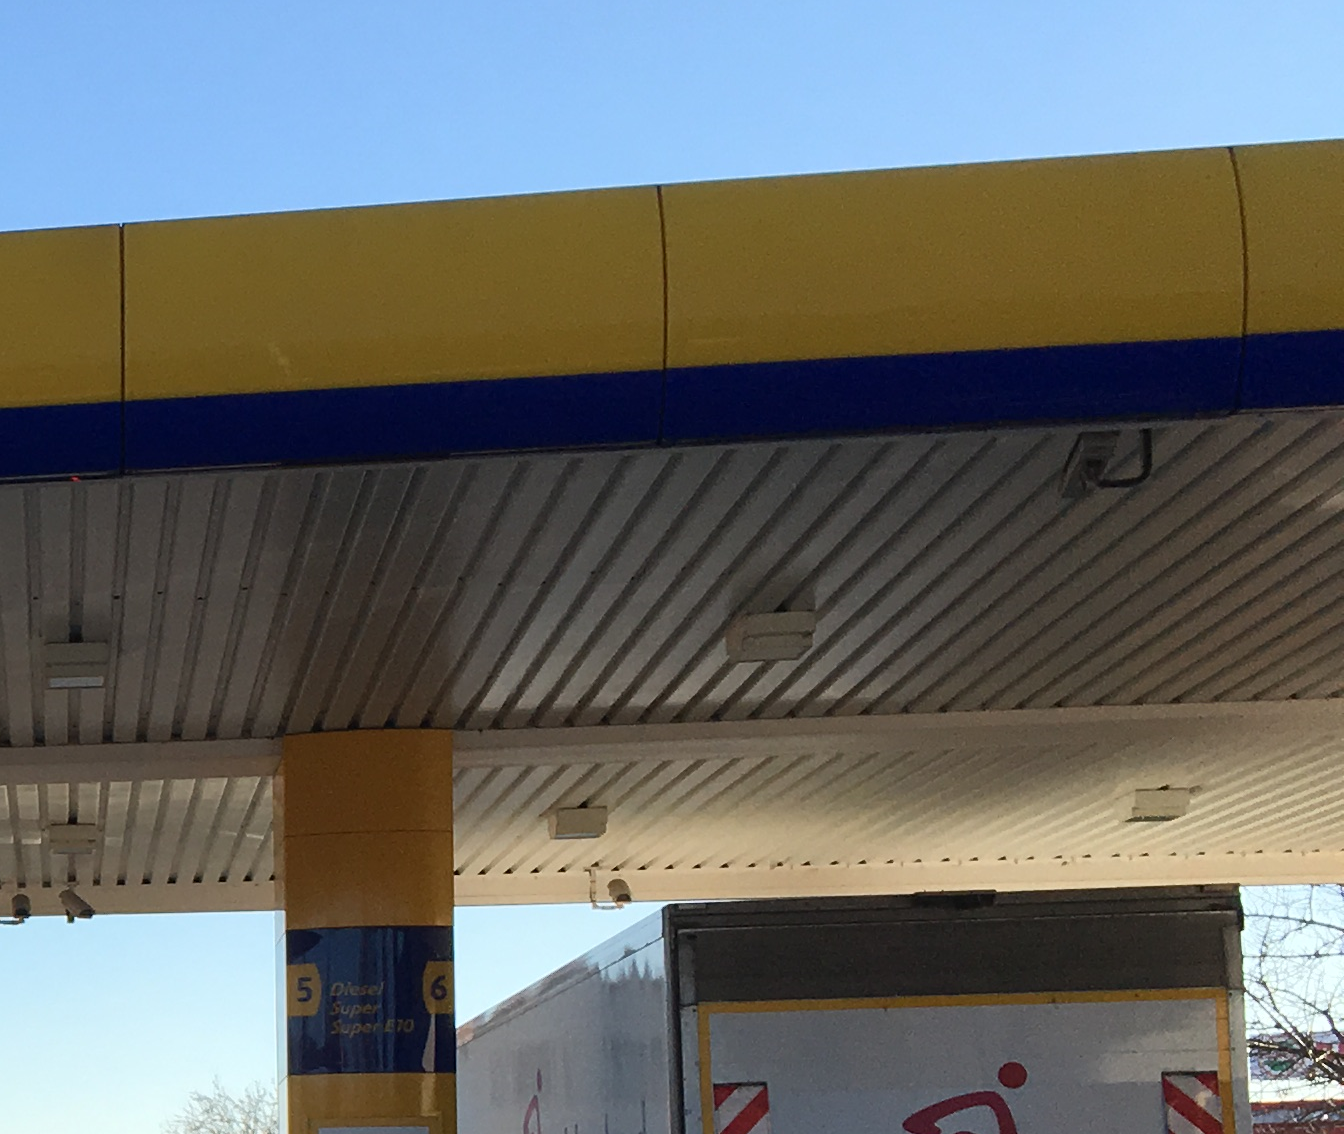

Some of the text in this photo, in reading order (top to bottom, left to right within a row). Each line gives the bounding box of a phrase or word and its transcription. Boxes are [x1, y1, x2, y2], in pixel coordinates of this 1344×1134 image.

[297, 977, 312, 1002] 5
[330, 981, 385, 996] Diesel
[430, 975, 447, 1000] 6
[330, 1002, 379, 1018] Super
[331, 1020, 381, 1038] Super
